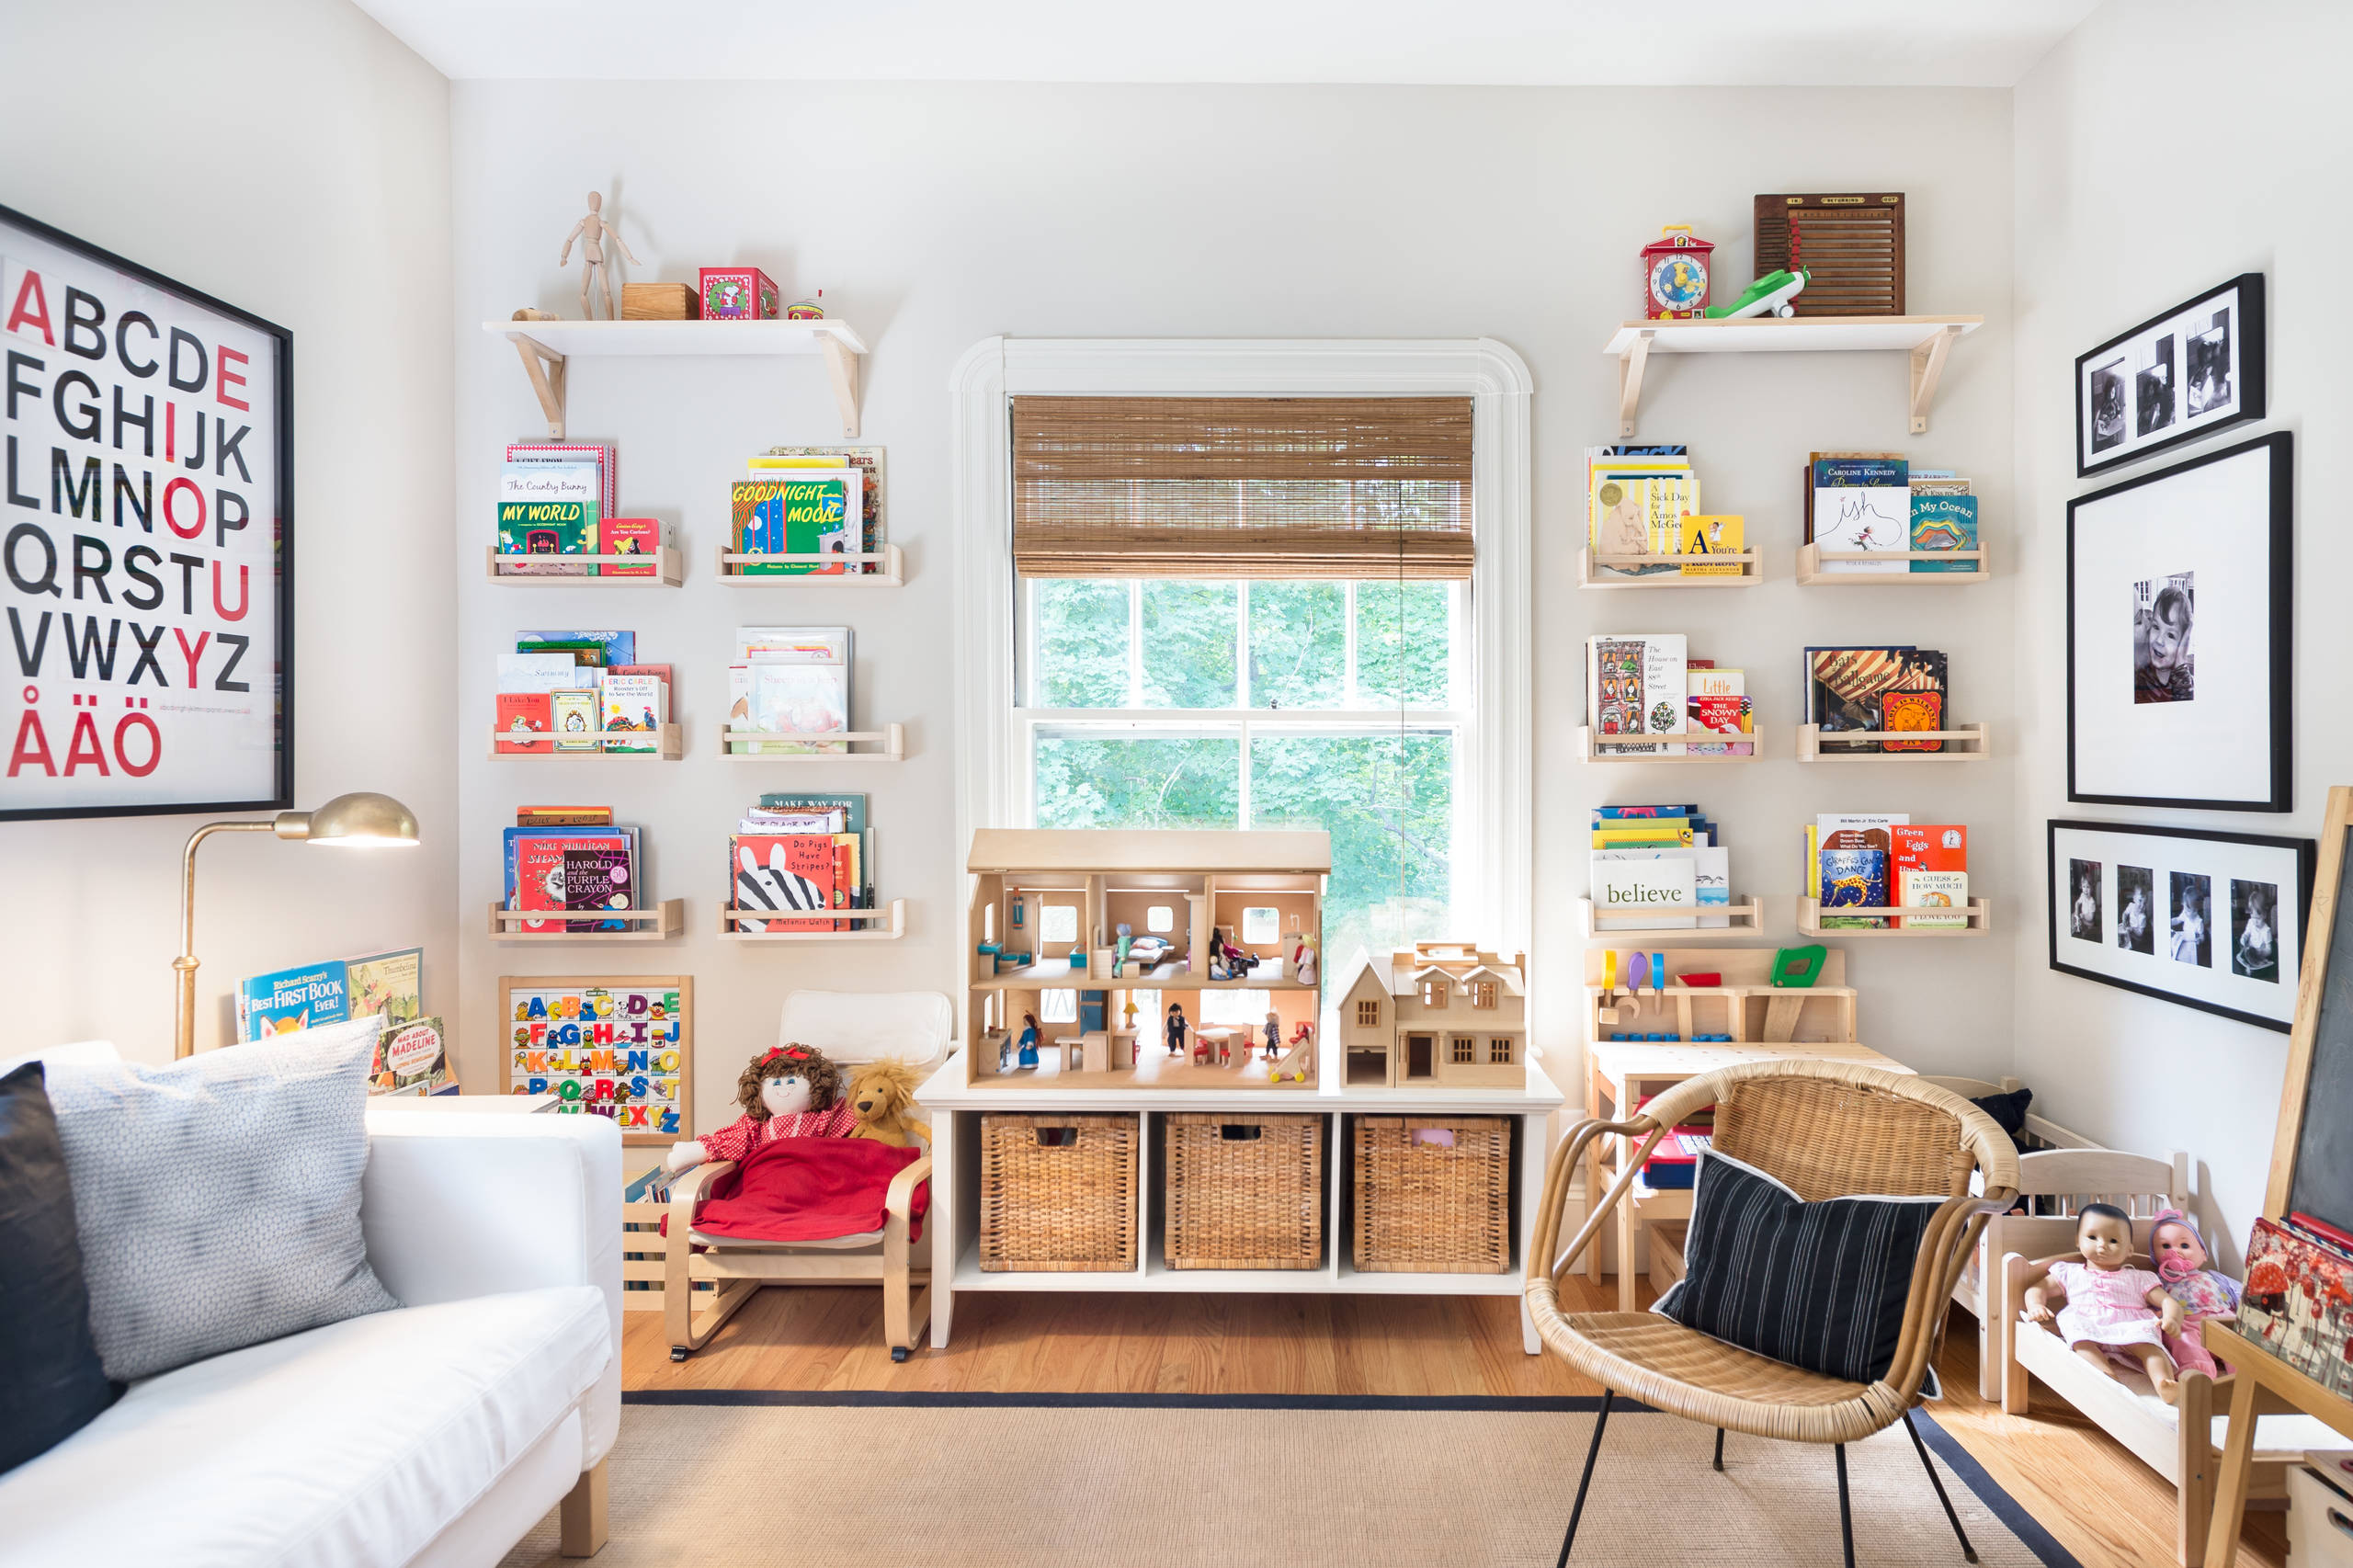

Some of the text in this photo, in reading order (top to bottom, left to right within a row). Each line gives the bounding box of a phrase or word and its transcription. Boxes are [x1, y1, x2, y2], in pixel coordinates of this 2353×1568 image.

[1827, 468, 1896, 476] CAROLINE KENNEDY
[507, 480, 587, 494] The Country Bunny
[733, 484, 827, 502] GOODNIGHT
[1651, 493, 1690, 503] Sick Day
[502, 504, 581, 521] MY WORLD
[788, 506, 836, 523] MOON
[1651, 510, 1677, 519] Amos
[1919, 500, 1972, 518] My Ocean
[1688, 529, 1710, 554] A
[1703, 677, 1731, 695] Little
[1834, 669, 1891, 690] Ballgame
[1701, 709, 1739, 717] SNOWY
[832, 800, 853, 808] FOR
[1896, 827, 1925, 836] Green
[533, 839, 610, 851] MIKE MULLIGAN
[793, 839, 828, 851] Do Pigs
[1906, 839, 1929, 852] Eggs
[528, 855, 565, 864] STEAM
[566, 860, 613, 869] HAROLD
[1899, 854, 1916, 862] and
[790, 861, 830, 871] Stripes?
[1836, 865, 1867, 875] DANCE
[567, 875, 610, 884] PURPLE
[567, 884, 612, 893] CRAYON
[1607, 883, 1682, 903] believe
[273, 971, 328, 990] Richard Scarry's
[251, 980, 344, 1013] BEST FIRST BOOK
[314, 995, 339, 1013] EVER!
[528, 993, 680, 1017] A B C D E
[529, 1021, 680, 1046] F G H I J
[392, 1034, 436, 1057] MADELINE
[527, 1050, 680, 1073] K L M N O
[529, 1075, 680, 1101] P Q R S T
[628, 1106, 648, 1126] X
[647, 1106, 666, 1127] Y
[662, 1112, 680, 1133] Z
